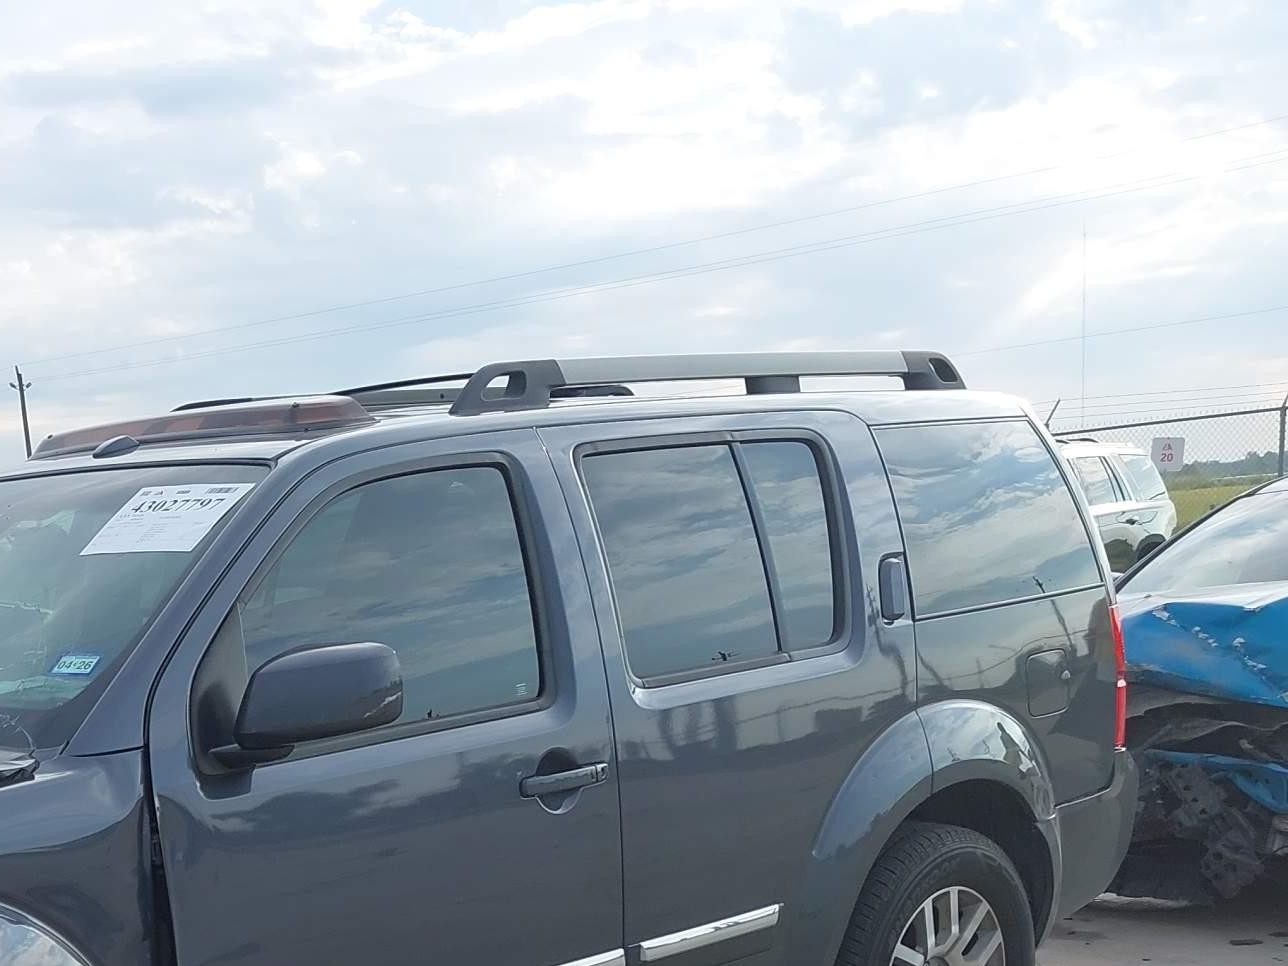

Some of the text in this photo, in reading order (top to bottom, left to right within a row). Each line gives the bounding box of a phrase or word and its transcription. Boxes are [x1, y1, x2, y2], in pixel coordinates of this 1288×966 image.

[1159, 453, 1174, 463] 20
[131, 498, 226, 513] 43027797
[75, 660, 93, 670] 26
